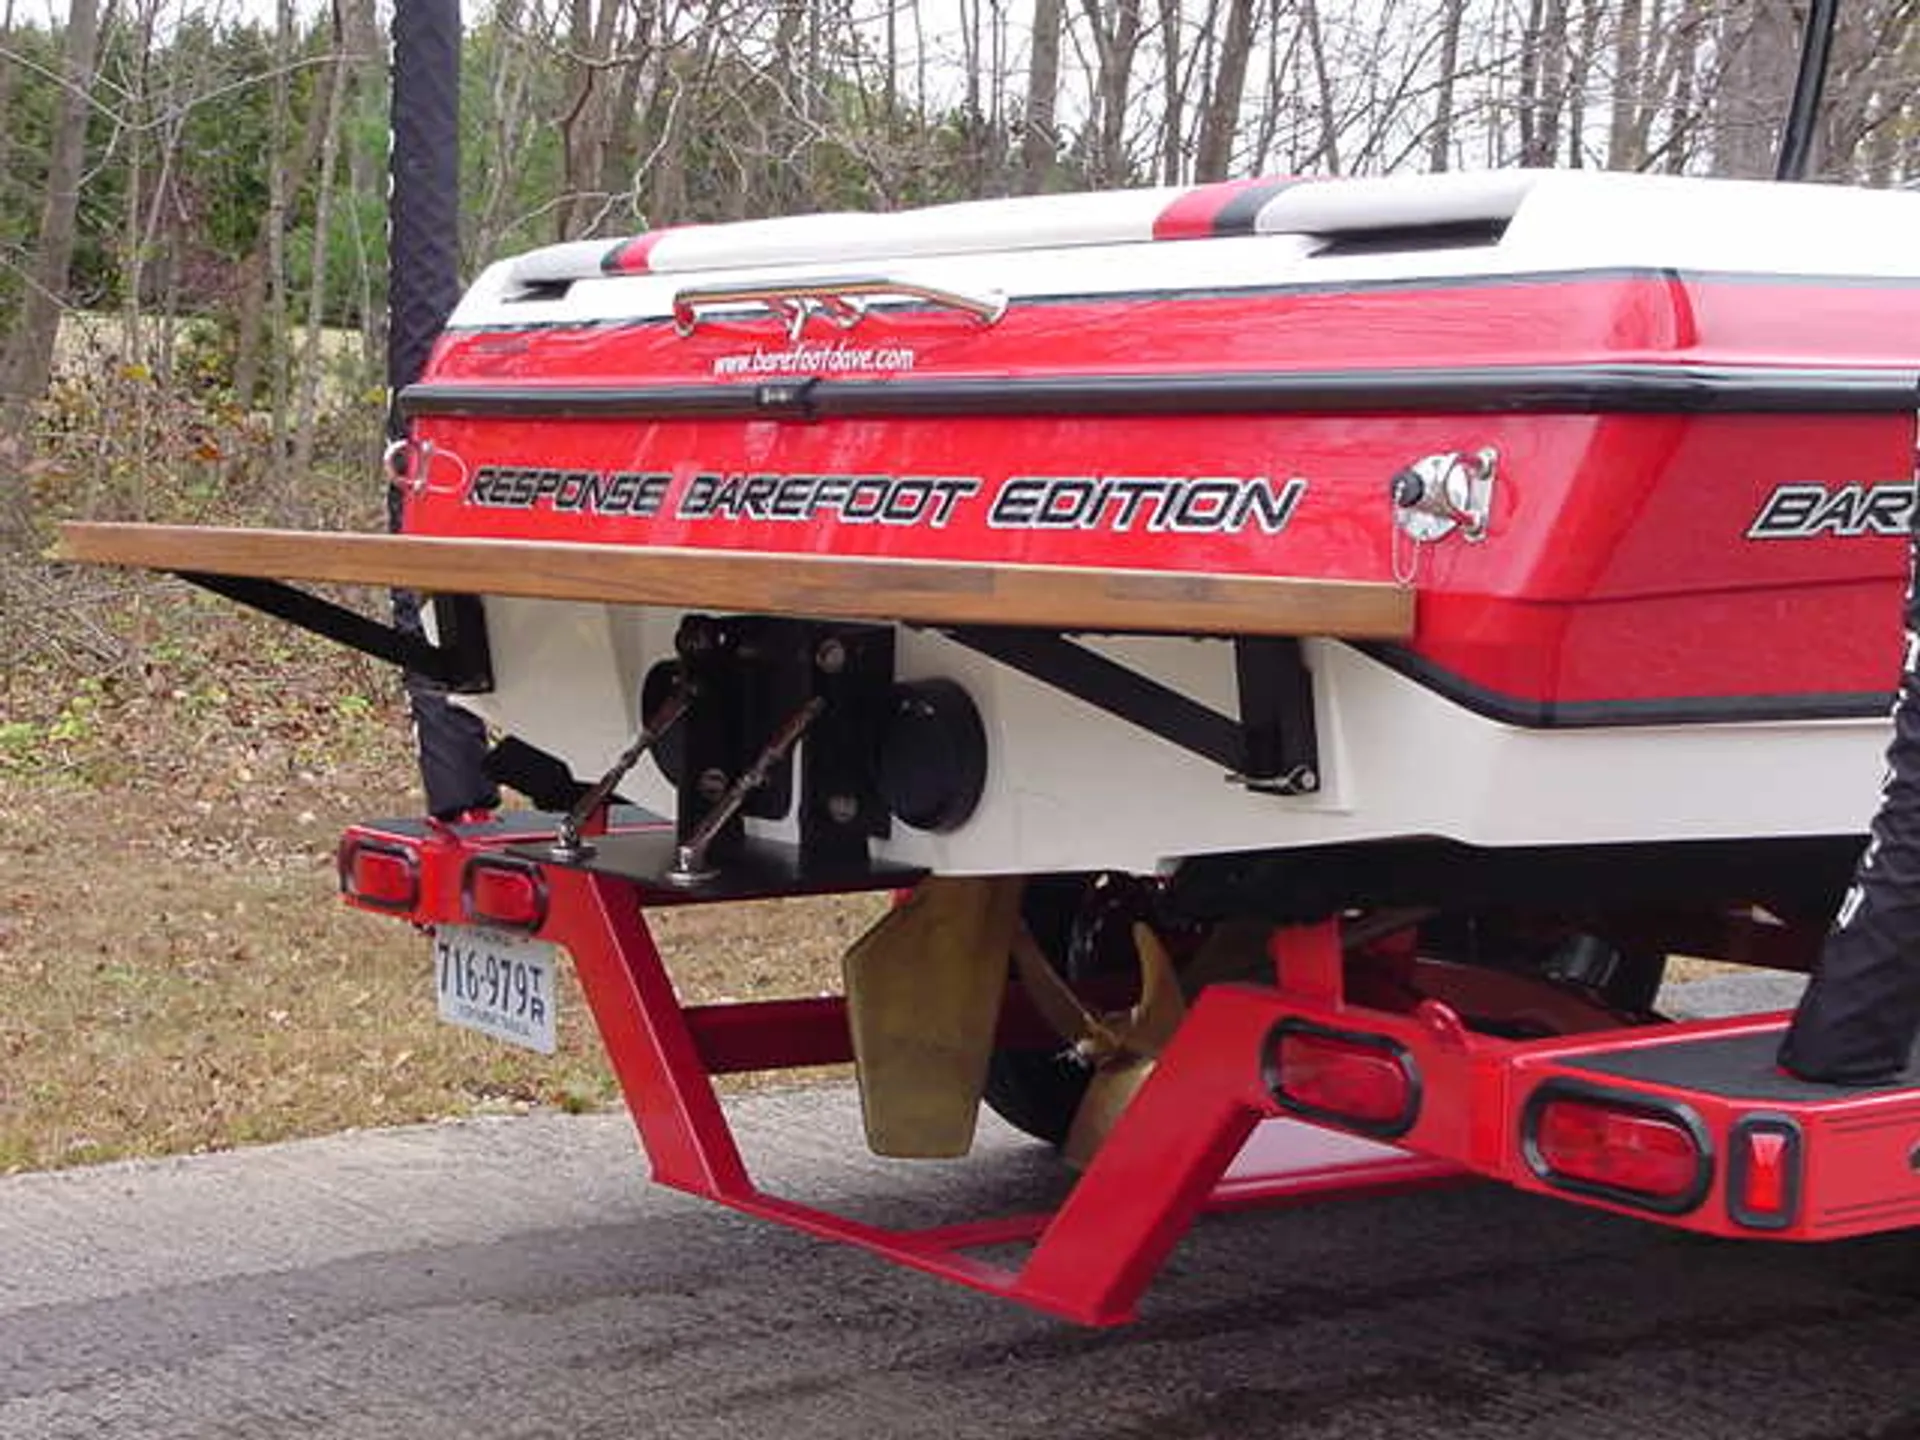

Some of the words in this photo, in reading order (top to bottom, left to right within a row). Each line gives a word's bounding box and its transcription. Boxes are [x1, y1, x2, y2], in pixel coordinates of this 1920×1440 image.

[714, 344, 914, 376] www.barefootdave.com
[466, 466, 672, 517] RESPONSE
[675, 473, 983, 528] BAREFOOT
[987, 475, 1307, 534] EDITION
[438, 942, 528, 1016] 716-979
